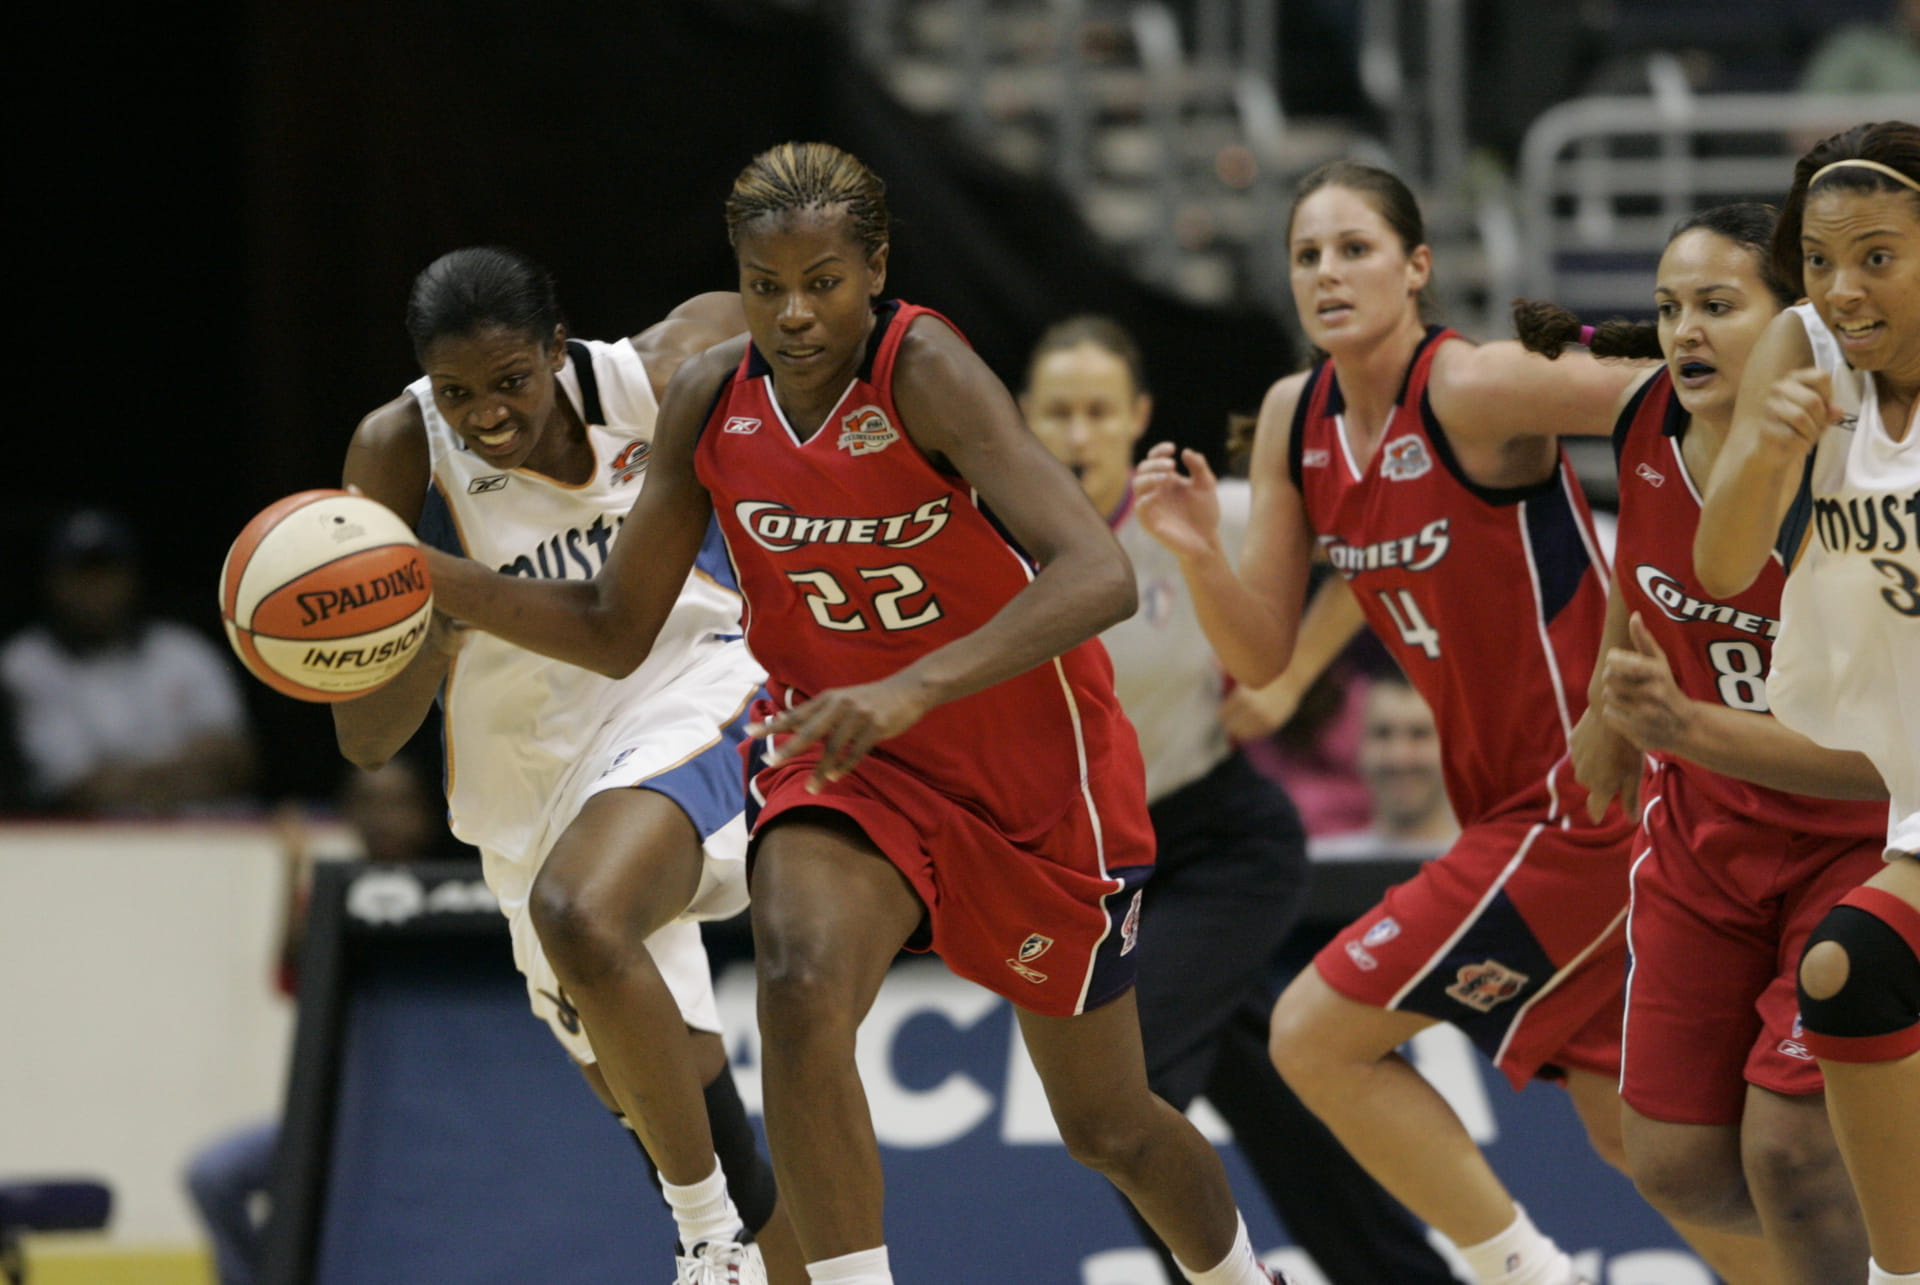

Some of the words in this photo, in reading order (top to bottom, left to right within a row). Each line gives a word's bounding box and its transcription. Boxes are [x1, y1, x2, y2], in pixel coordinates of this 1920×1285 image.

[296, 558, 425, 627] SPALDING
[785, 562, 945, 633] 22
[1376, 588, 1442, 660] 4
[1706, 638, 1771, 714] 8
